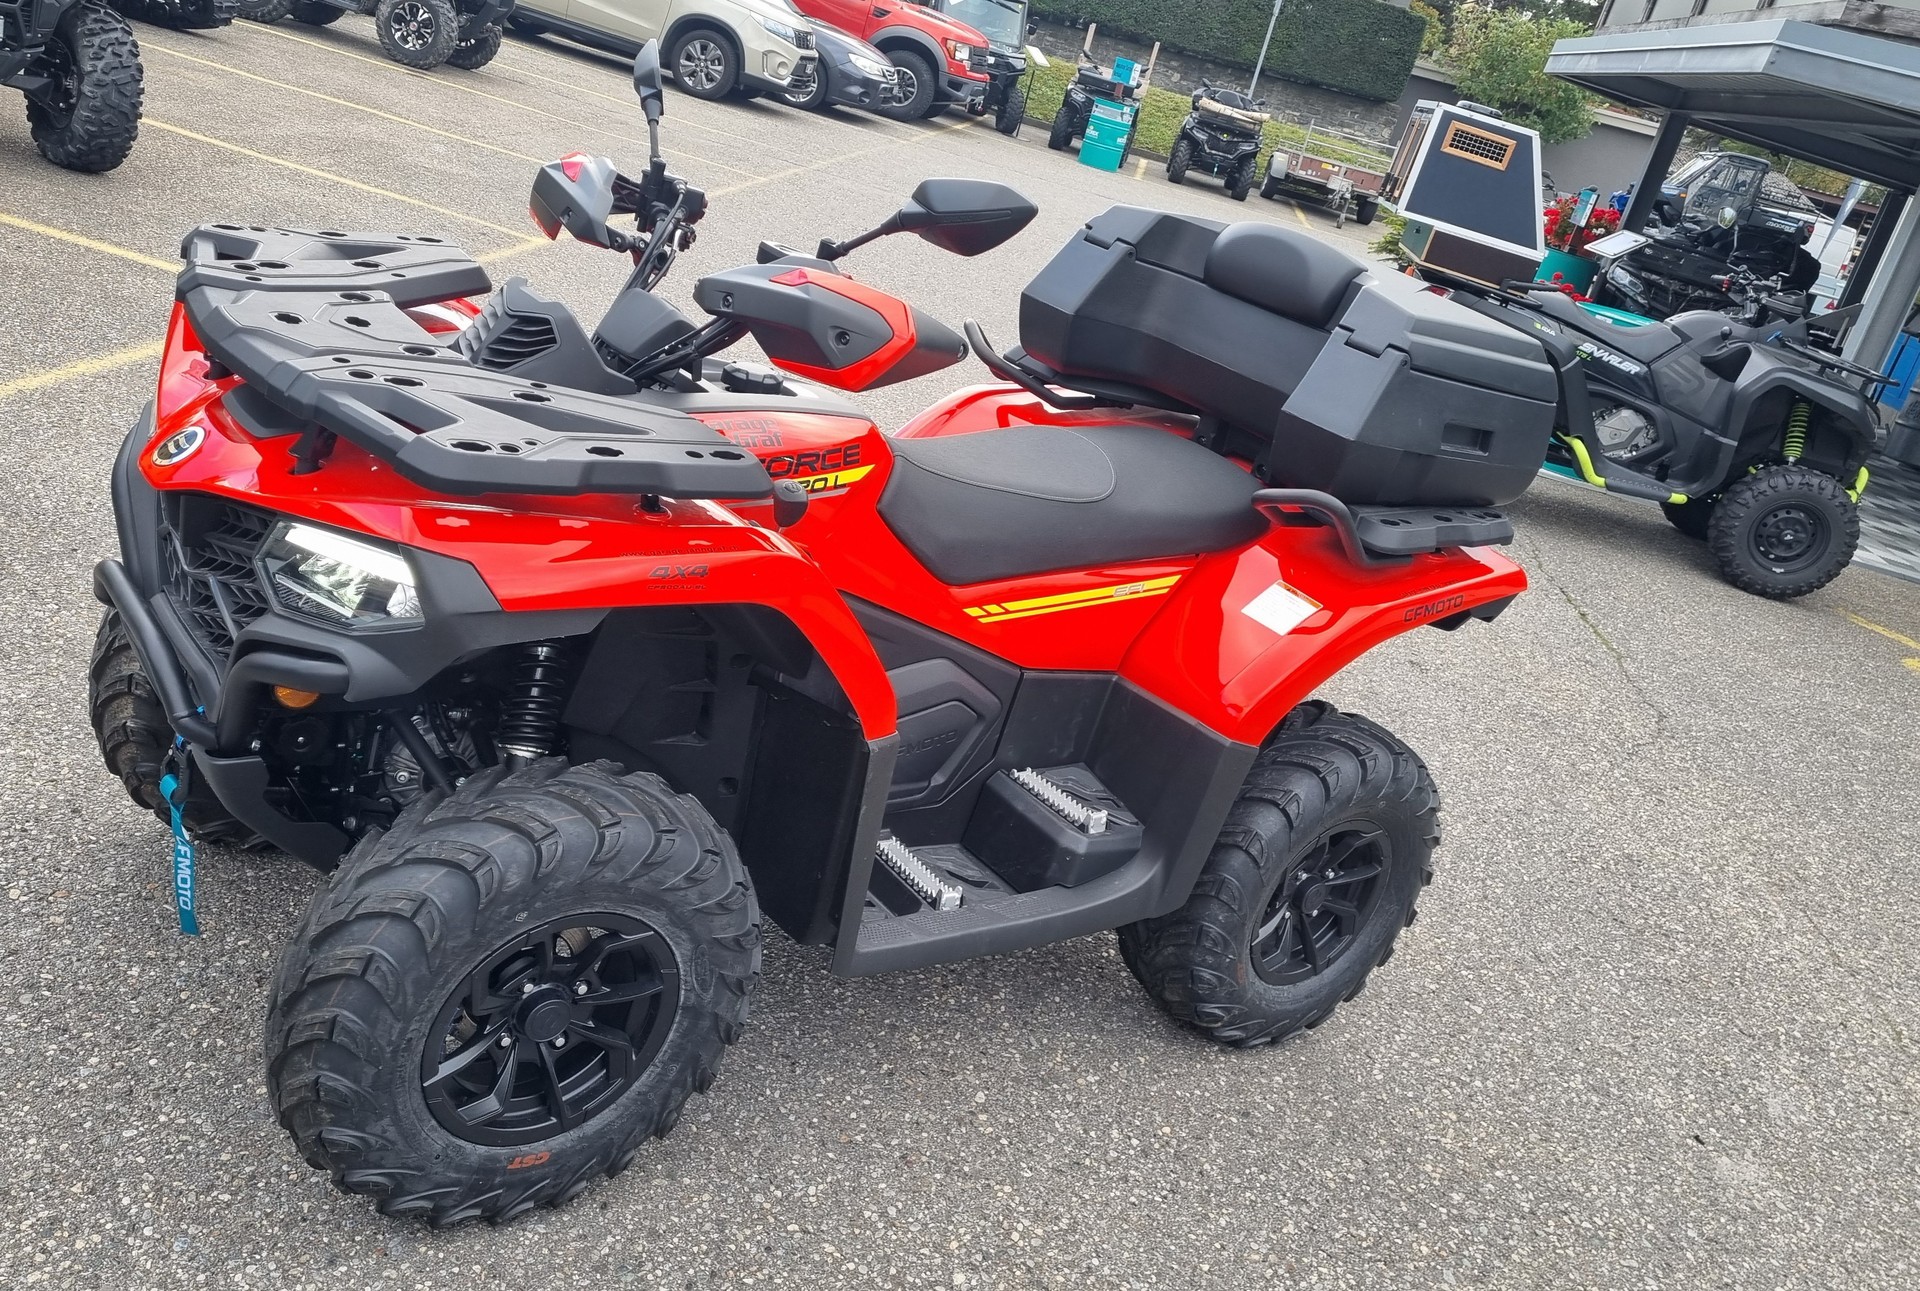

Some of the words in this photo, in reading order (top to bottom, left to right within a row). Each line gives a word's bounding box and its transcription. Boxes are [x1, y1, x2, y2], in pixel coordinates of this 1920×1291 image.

[1578, 342, 1641, 375] SNARLER
[708, 418, 779, 434] arage
[833, 474, 847, 489] L
[1113, 583, 1144, 597] EFI
[1404, 595, 1464, 622] CFMOTO
[506, 1151, 551, 1169] CST
